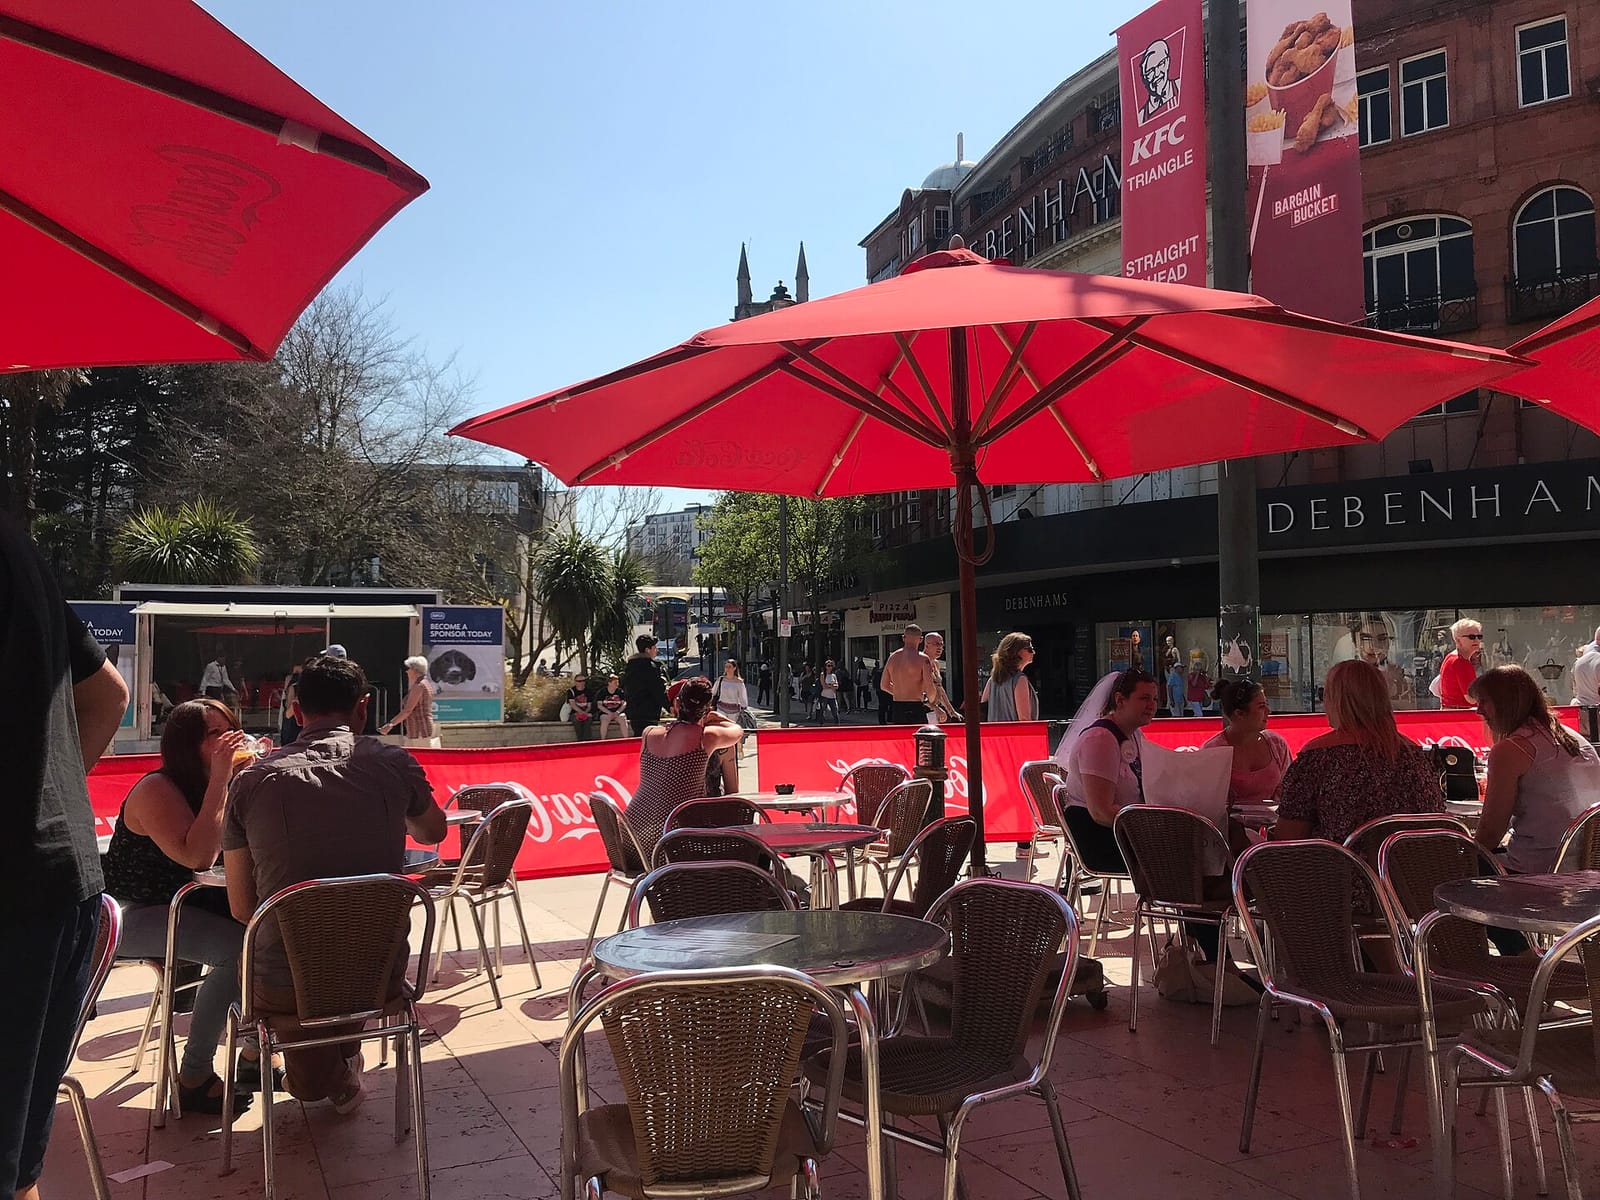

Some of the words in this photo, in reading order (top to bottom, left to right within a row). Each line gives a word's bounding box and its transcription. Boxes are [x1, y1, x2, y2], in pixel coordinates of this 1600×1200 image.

[1129, 115, 1187, 166] KFC
[1126, 149, 1194, 192] TRIANGLE
[1274, 183, 1321, 216] BARGAIN
[1293, 194, 1337, 225] BUCKET
[1125, 235, 1200, 277] STRAIGHT
[1141, 262, 1188, 283] EAD
[879, 603, 909, 612] PIZZA
[1005, 592, 1068, 610] DEBENHAMS
